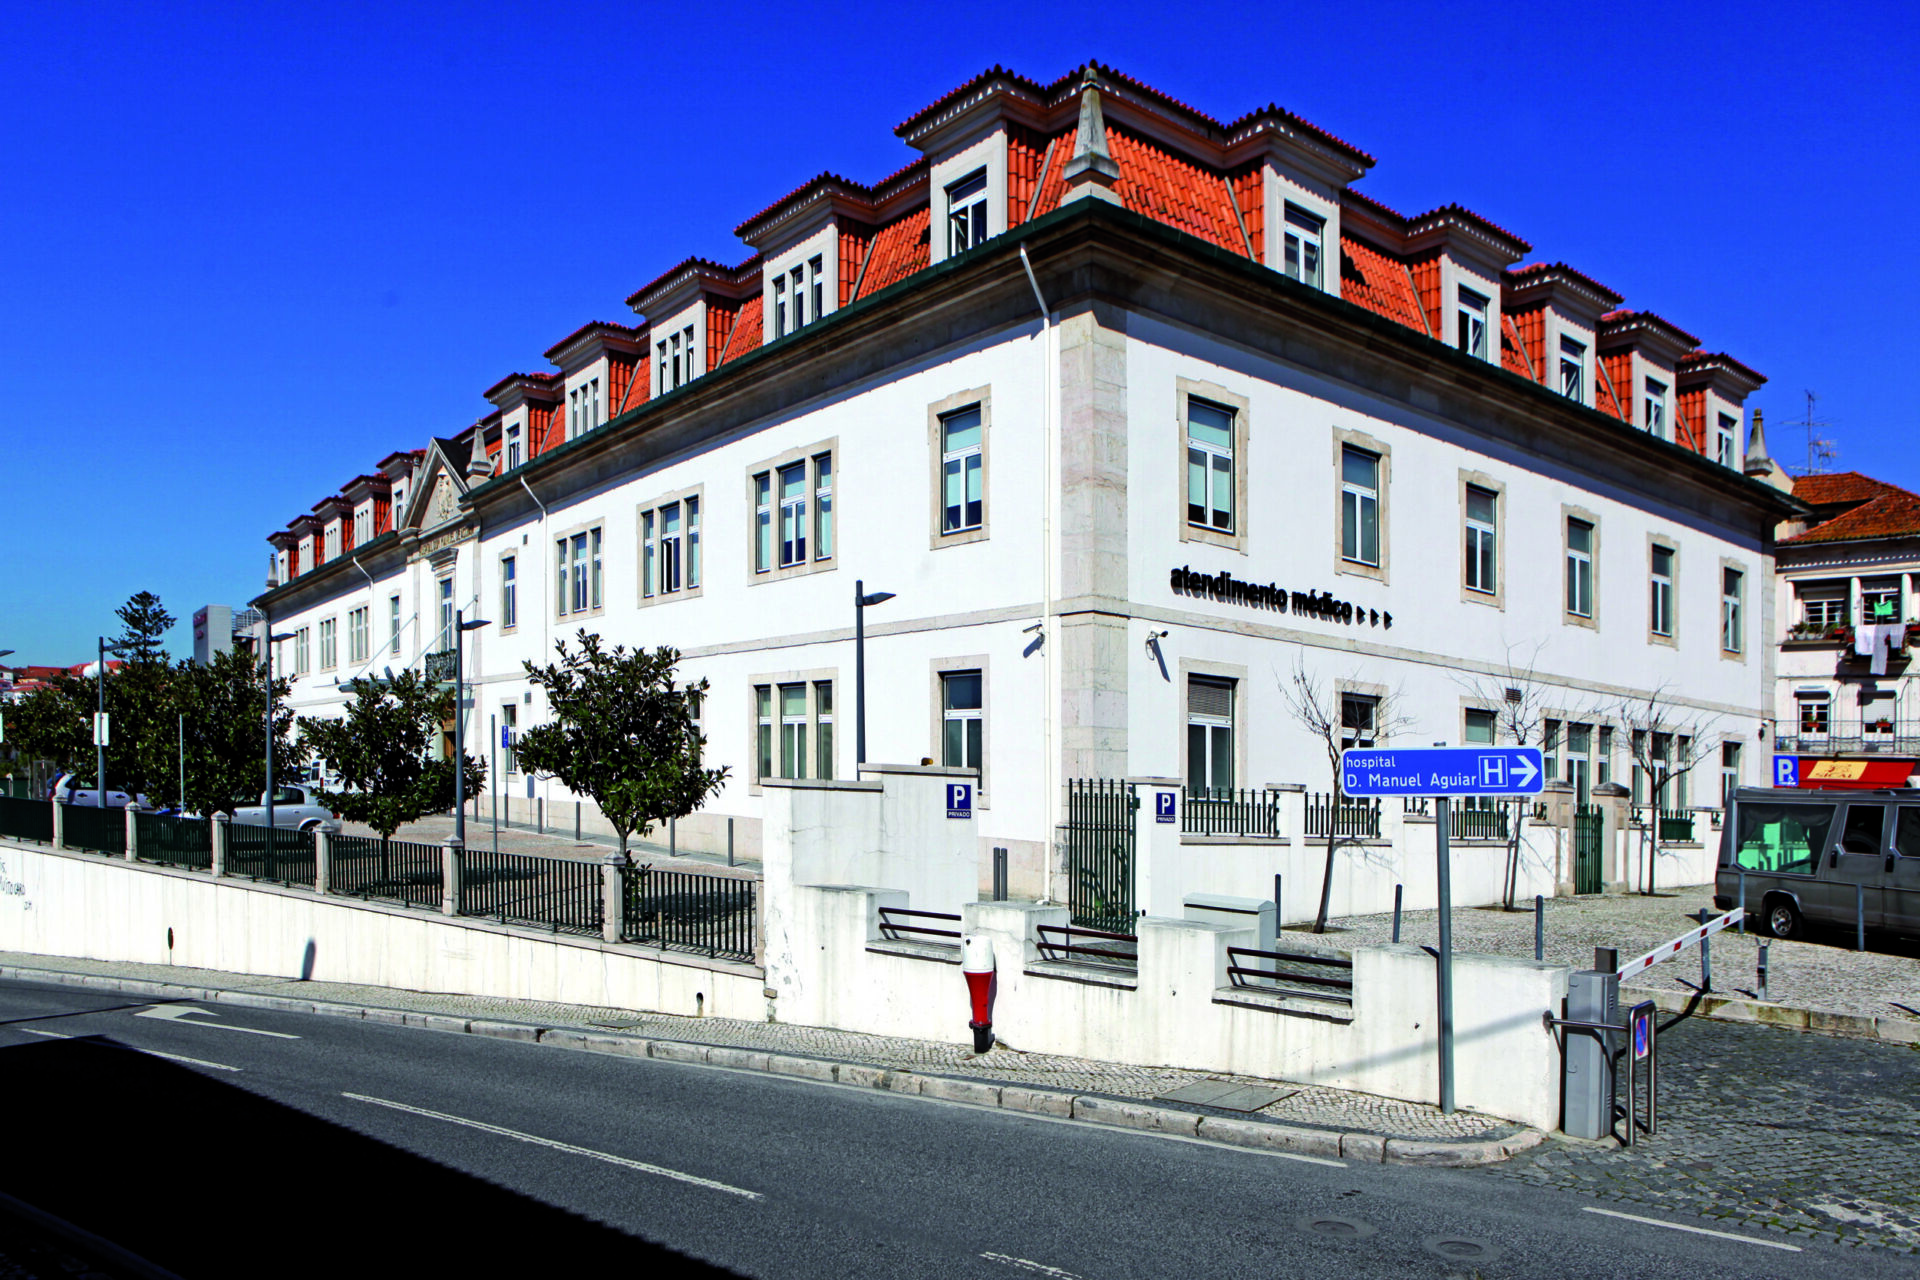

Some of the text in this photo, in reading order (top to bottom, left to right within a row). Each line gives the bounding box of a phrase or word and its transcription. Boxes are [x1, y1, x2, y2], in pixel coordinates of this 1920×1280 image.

[1170, 564, 1353, 620] atendimento médico
[1346, 755, 1396, 770] hospital
[1484, 758, 1503, 785] H
[1777, 758, 1794, 782] P
[1347, 772, 1477, 789] D. Manuel Aguiar
[953, 785, 966, 809] P
[1161, 793, 1171, 815] P
